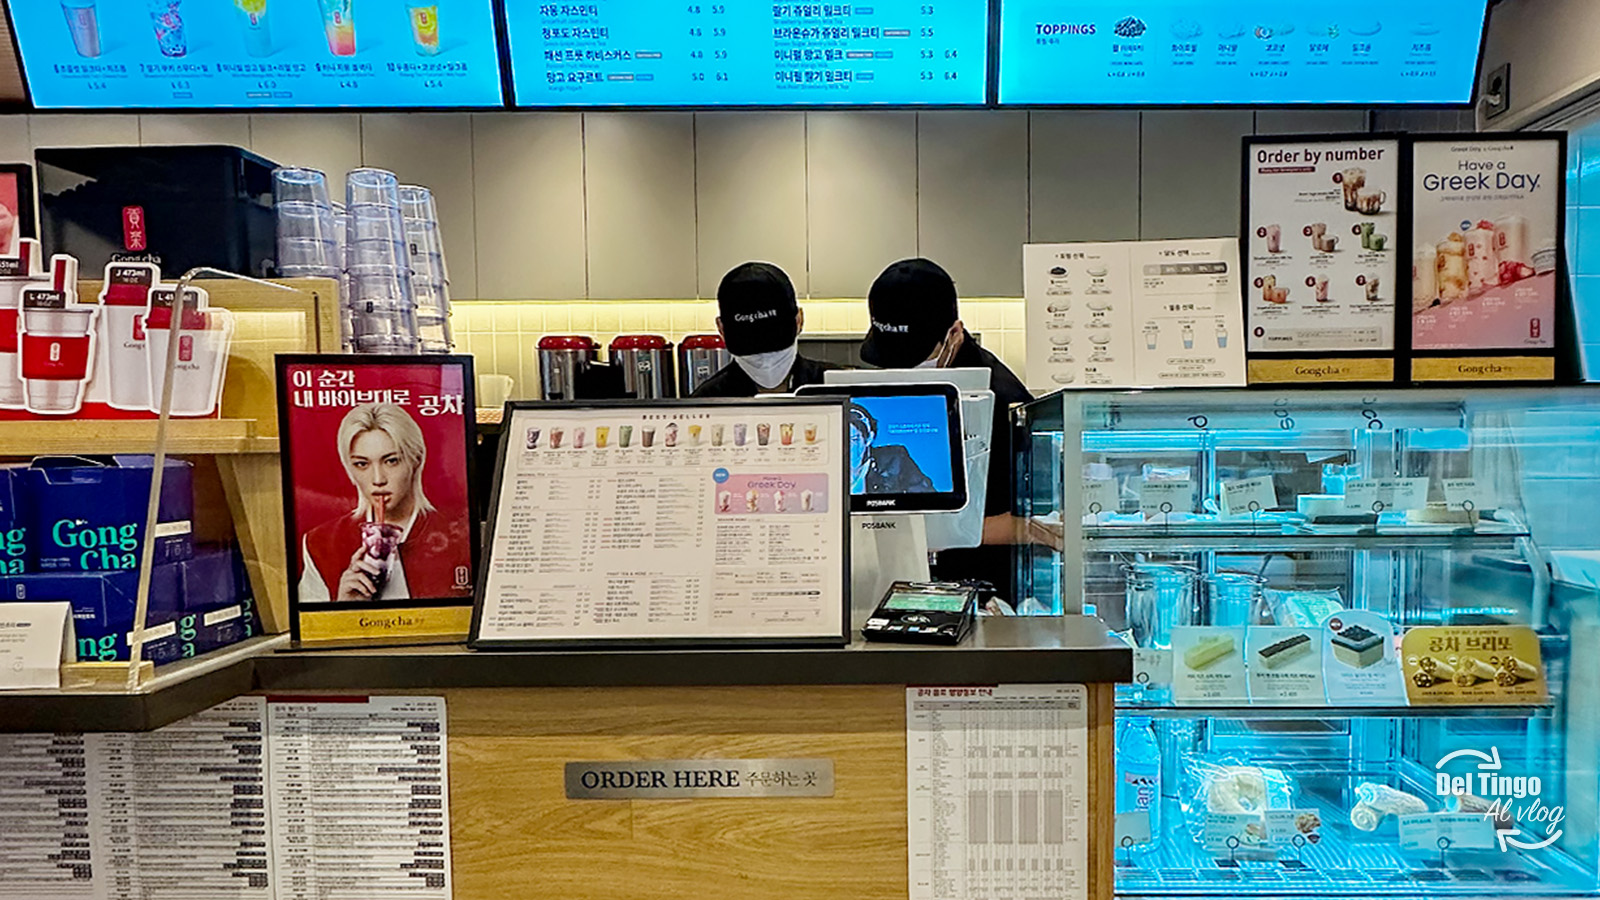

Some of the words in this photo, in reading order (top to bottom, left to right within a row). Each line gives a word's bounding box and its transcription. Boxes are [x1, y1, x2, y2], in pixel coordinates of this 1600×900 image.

[540, 5, 558, 17] 자몽
[560, 5, 598, 17] 자스민티
[687, 6, 700, 14] 4.8
[712, 6, 725, 14] 5.9
[793, 5, 822, 17] 쥬얼리
[823, 5, 851, 17] 밀크티
[921, 6, 934, 15] 5.3
[542, 27, 570, 39] 청포도
[572, 28, 609, 39] 자스민티
[689, 29, 702, 37] 4.8
[713, 28, 726, 37] 5.9
[773, 27, 820, 39] 브라운슈가
[822, 27, 850, 39] 쥬얼리
[852, 27, 879, 39] 밀크티
[921, 29, 934, 37] 5.5
[1036, 24, 1096, 35] TOPPINGS
[544, 50, 563, 61] 패션
[586, 50, 631, 61] 히비스커스
[714, 51, 727, 59] 5.9
[774, 49, 802, 60] 미니펄
[804, 49, 823, 60] 망고
[825, 49, 843, 60] 밀크
[921, 51, 934, 59] 5.3
[546, 72, 565, 83] 망고
[692, 73, 704, 81] 5.0
[716, 73, 728, 81] 6.1
[775, 71, 803, 82] 미니펄
[825, 71, 853, 82] 밀크티
[921, 72, 934, 80] 5.3
[945, 72, 958, 80] 6.4
[1257, 150, 1300, 163] Order
[1304, 149, 1320, 165] by
[1325, 147, 1385, 162] number
[1458, 160, 1493, 171] Have
[1497, 161, 1506, 170] a
[1423, 174, 1490, 191] Greek
[122, 269, 146, 277] 473ml
[29, 293, 34, 301] L
[37, 293, 60, 301] 473ml
[158, 293, 163, 301] L
[293, 370, 312, 387] 이
[318, 370, 355, 388] 순간
[293, 390, 313, 407] 내
[318, 390, 411, 407] 바이브대로
[417, 395, 464, 416] 공차
[777, 480, 796, 489] Day
[866, 499, 896, 507] POSBANK
[862, 522, 896, 530] POSBANK
[52, 520, 137, 551] Gong
[80, 548, 136, 570] Cha
[77, 633, 119, 661] ng
[1429, 636, 1461, 653] 공차
[1466, 636, 1513, 652] 브리또
[581, 771, 668, 789] ORDER
[674, 770, 740, 788] HERE
[745, 771, 801, 788] 주문하는
[802, 771, 818, 788] 곳
